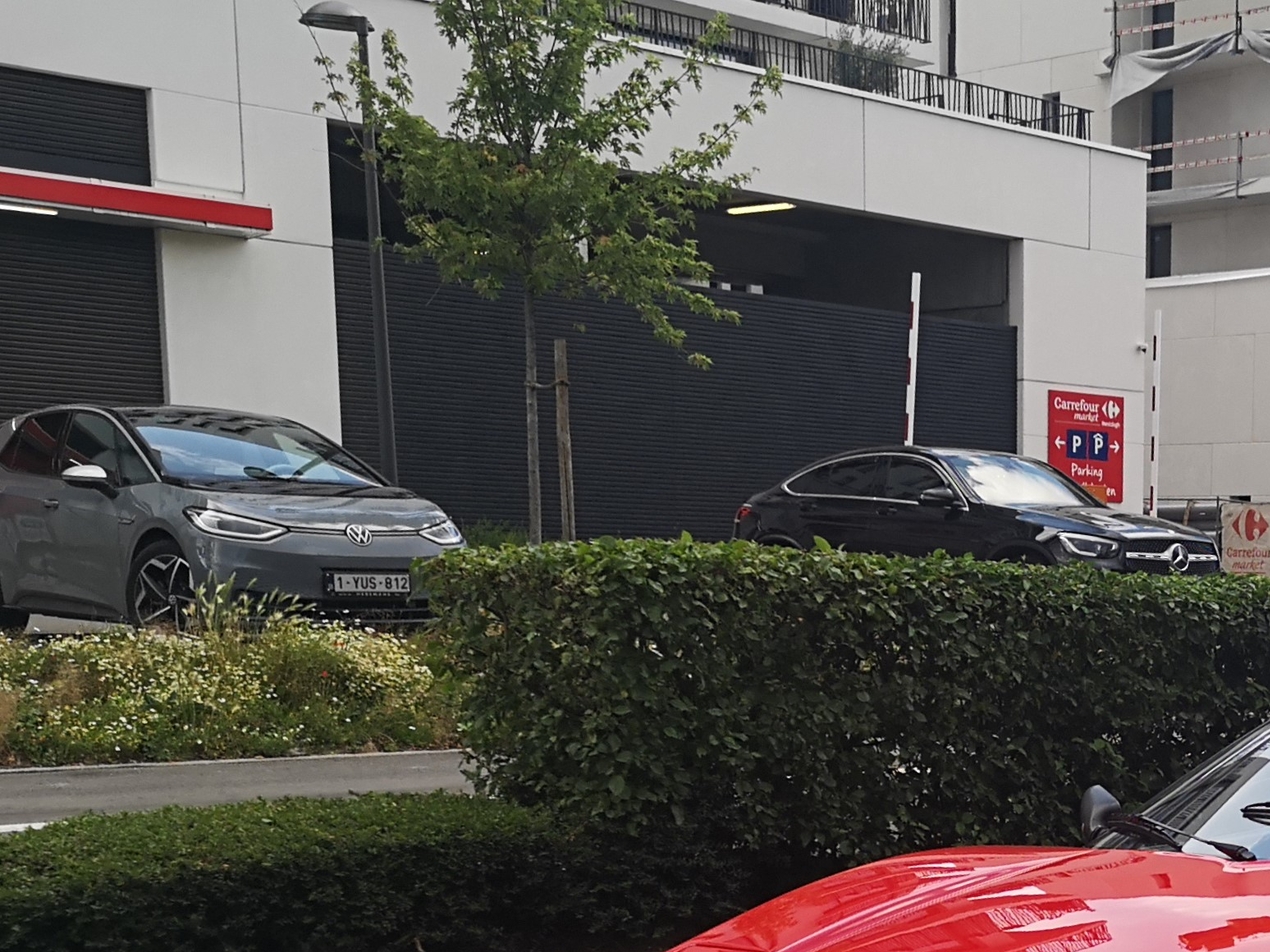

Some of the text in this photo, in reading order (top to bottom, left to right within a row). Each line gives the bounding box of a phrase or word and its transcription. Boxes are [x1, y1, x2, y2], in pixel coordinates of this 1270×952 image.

[1054, 397, 1100, 412] Carrefour
[1074, 412, 1098, 422] market
[1073, 435, 1081, 453] P
[1071, 462, 1103, 482] Parking
[1232, 560, 1265, 570] market
[336, 576, 409, 590] 1-YUS-812
